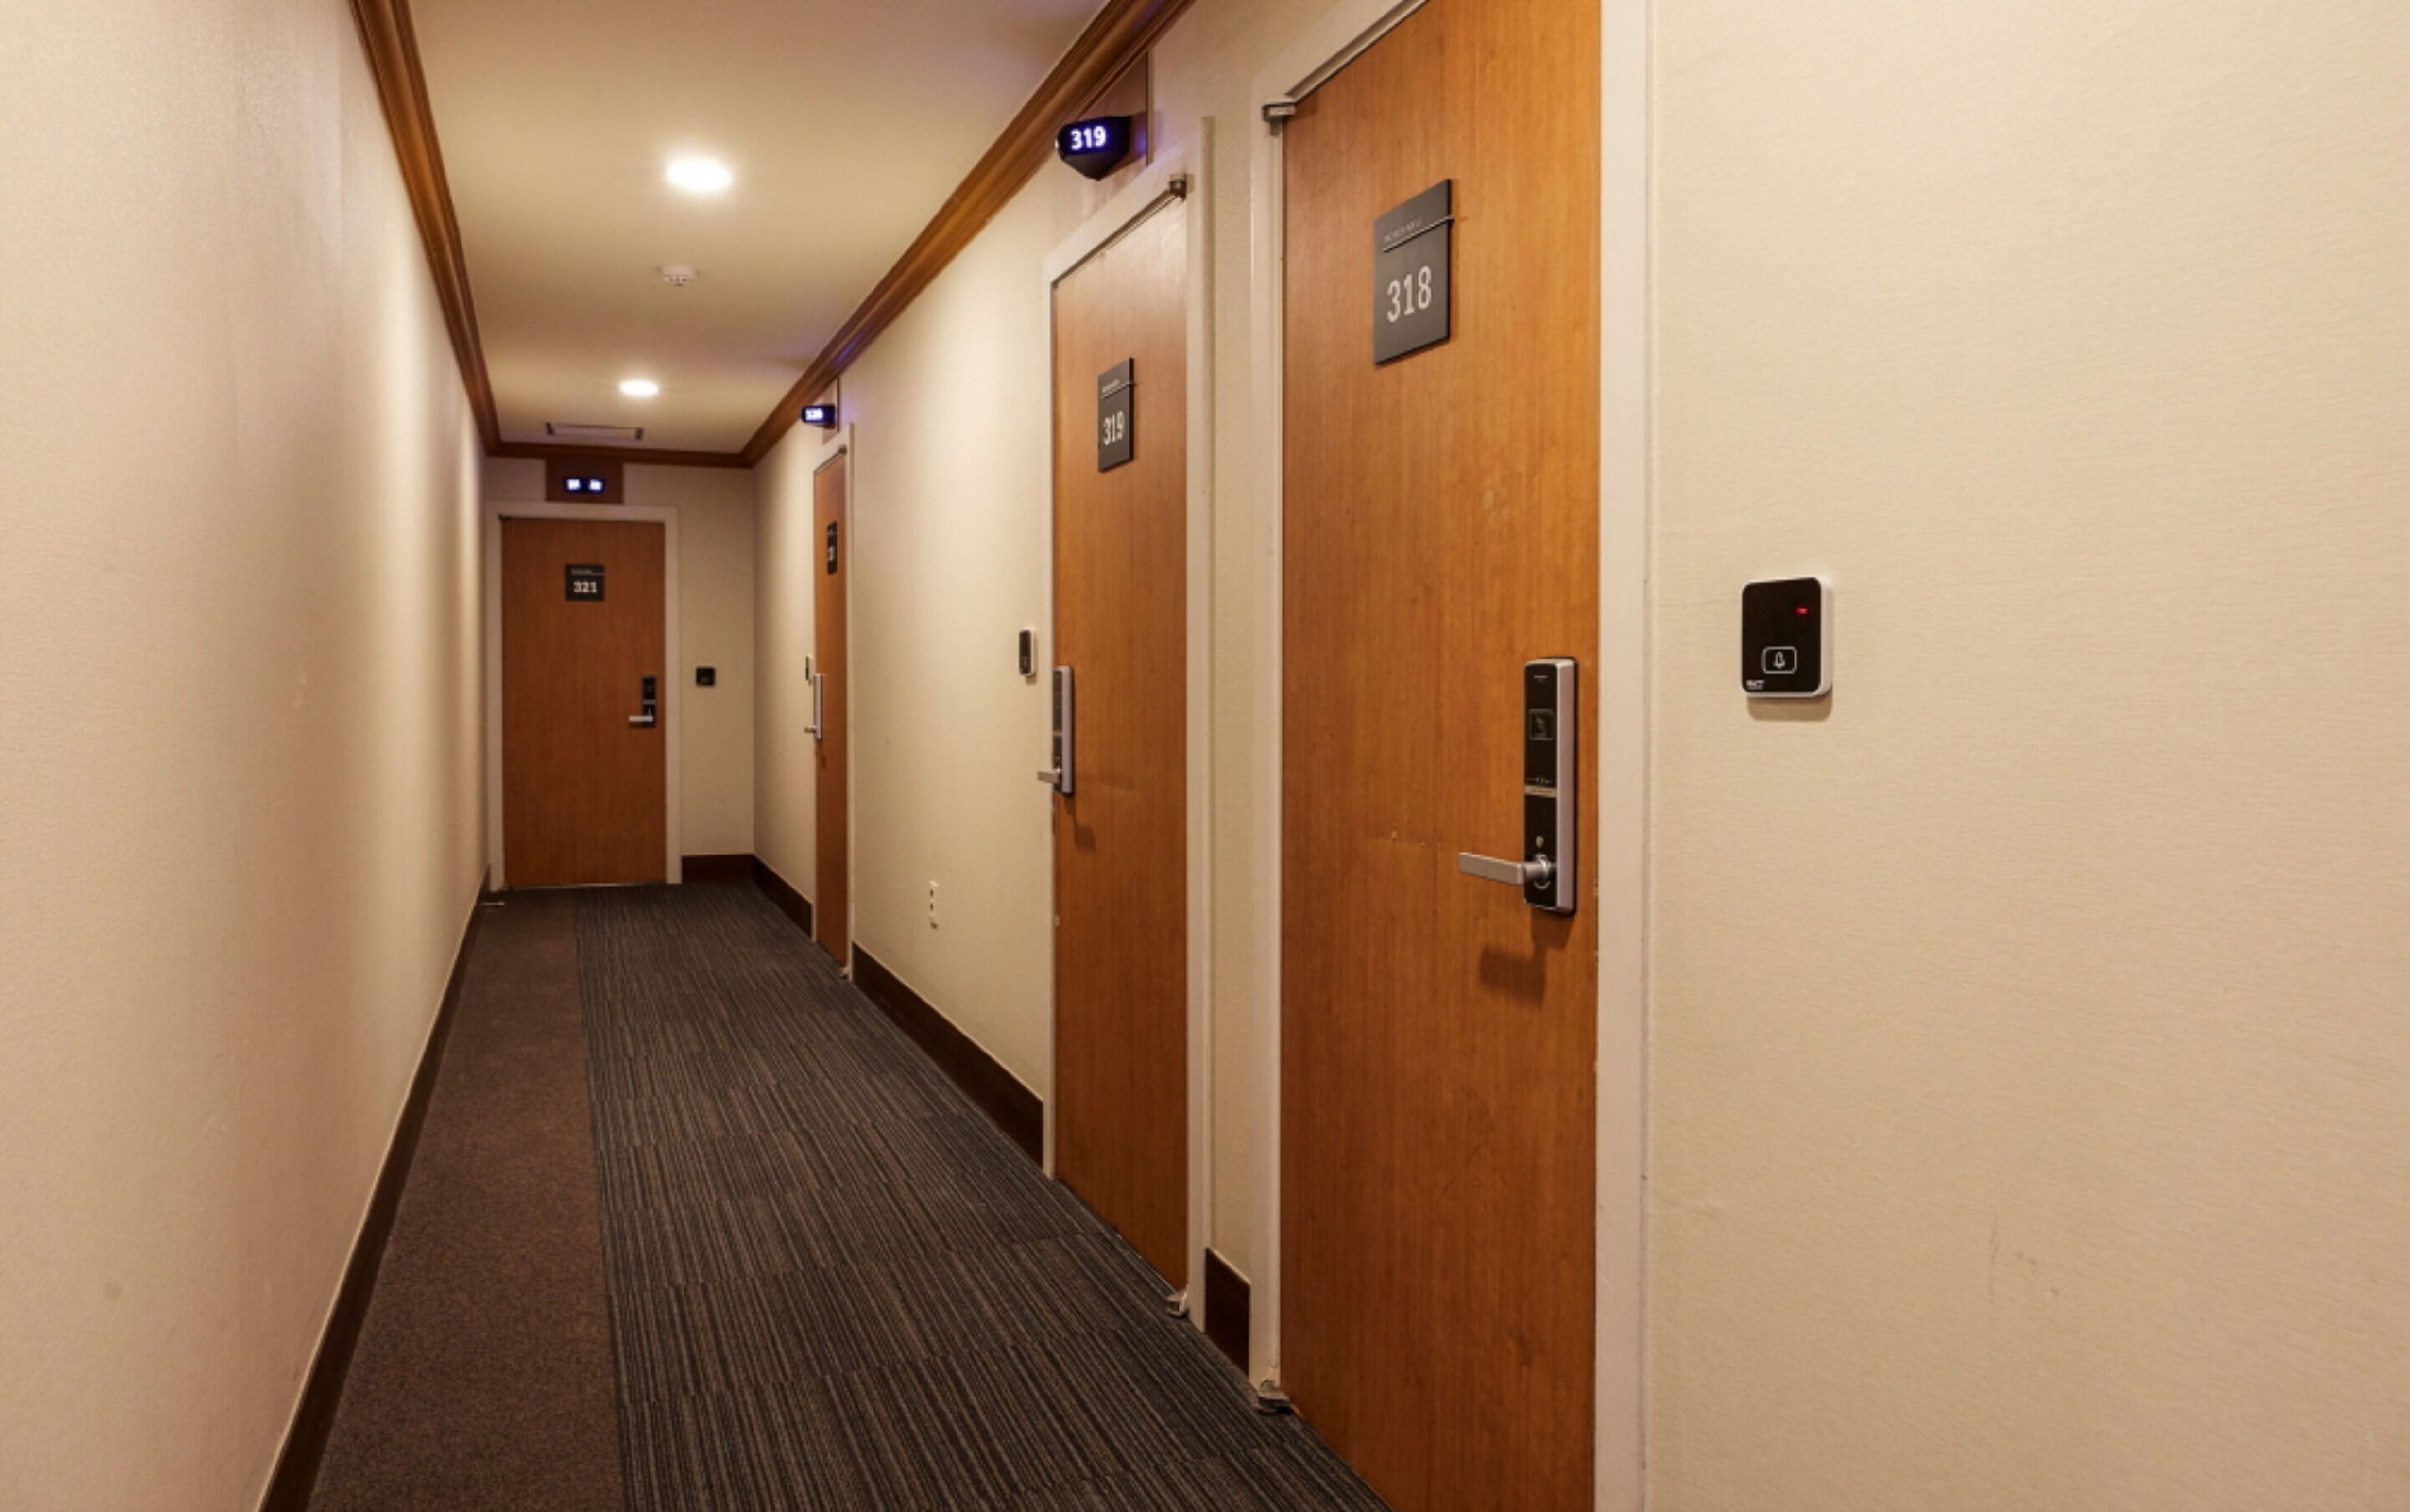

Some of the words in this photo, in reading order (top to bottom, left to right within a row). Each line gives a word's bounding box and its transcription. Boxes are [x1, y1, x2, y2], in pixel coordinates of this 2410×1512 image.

[1071, 126, 1106, 151] 319
[1387, 265, 1432, 323] 318
[1103, 411, 1125, 445] 319
[573, 581, 597, 592] 321
